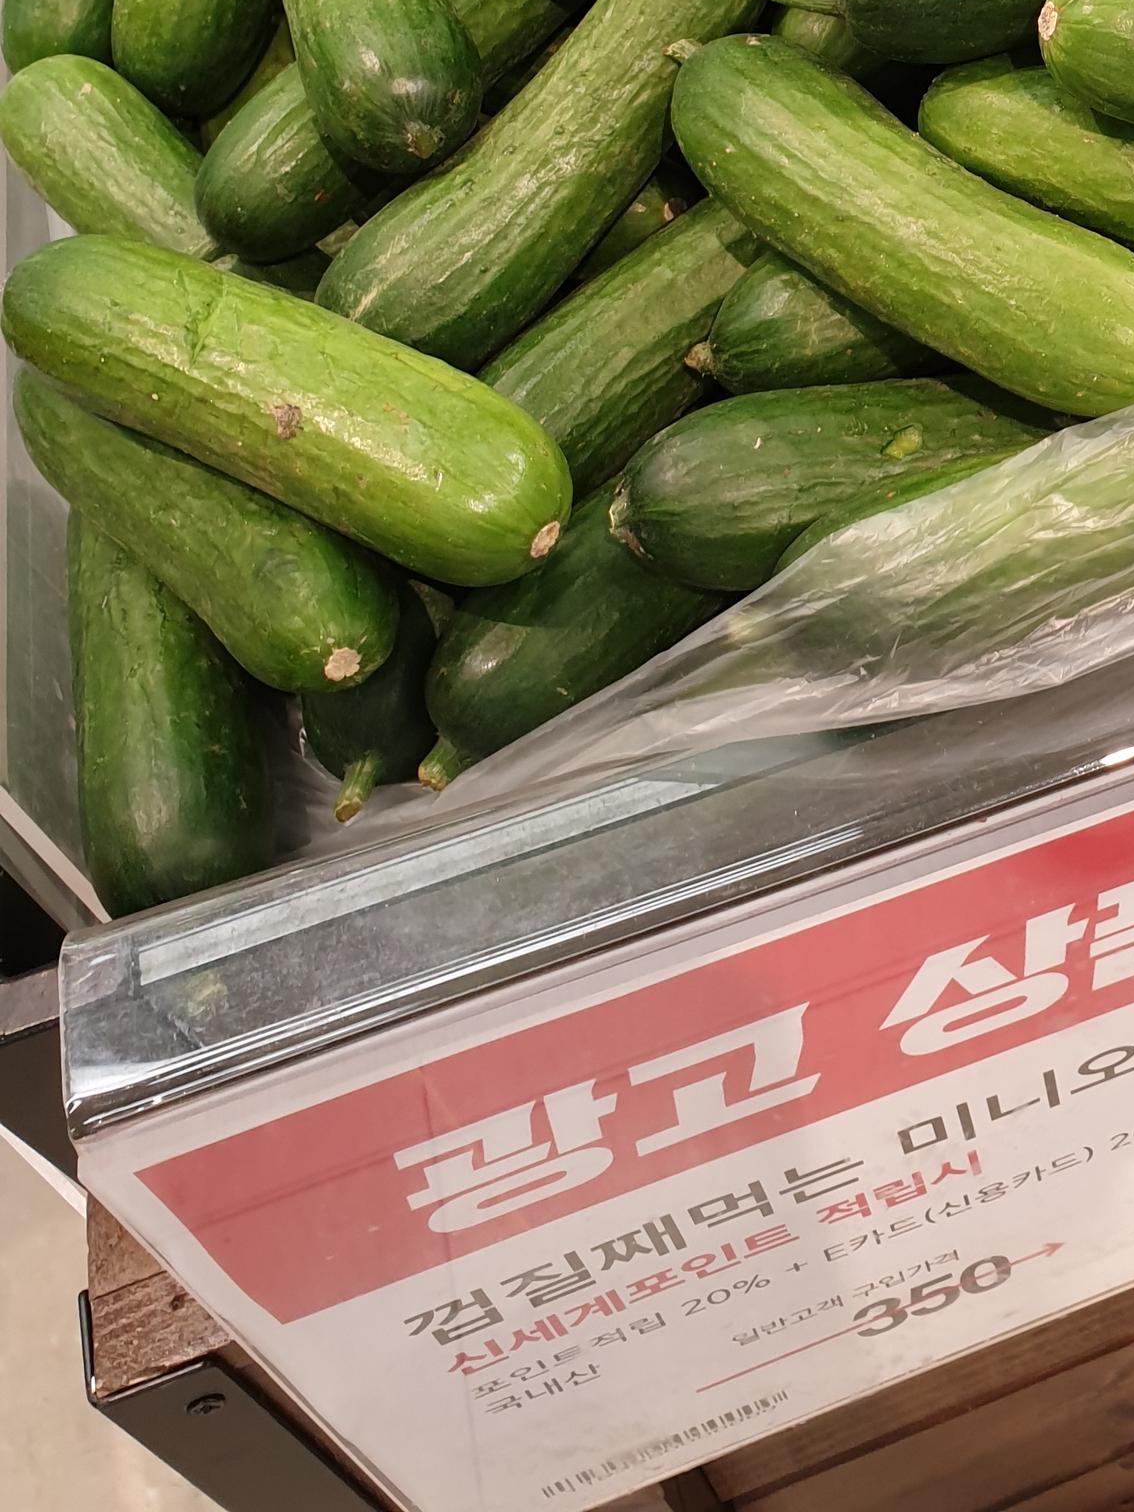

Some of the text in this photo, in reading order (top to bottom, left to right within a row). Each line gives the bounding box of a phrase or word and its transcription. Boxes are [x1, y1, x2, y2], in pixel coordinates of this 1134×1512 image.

[394, 1002, 821, 1233] 광고
[404, 1157, 864, 1345] 껍질째먹는
[448, 1150, 982, 1376] 신세계포인트 적립시
[681, 1274, 771, 1316] 20%
[823, 1146, 1093, 1262] E카드(신용카드)
[853, 1255, 1012, 1338] 350
[485, 1363, 600, 1414] 국내산
